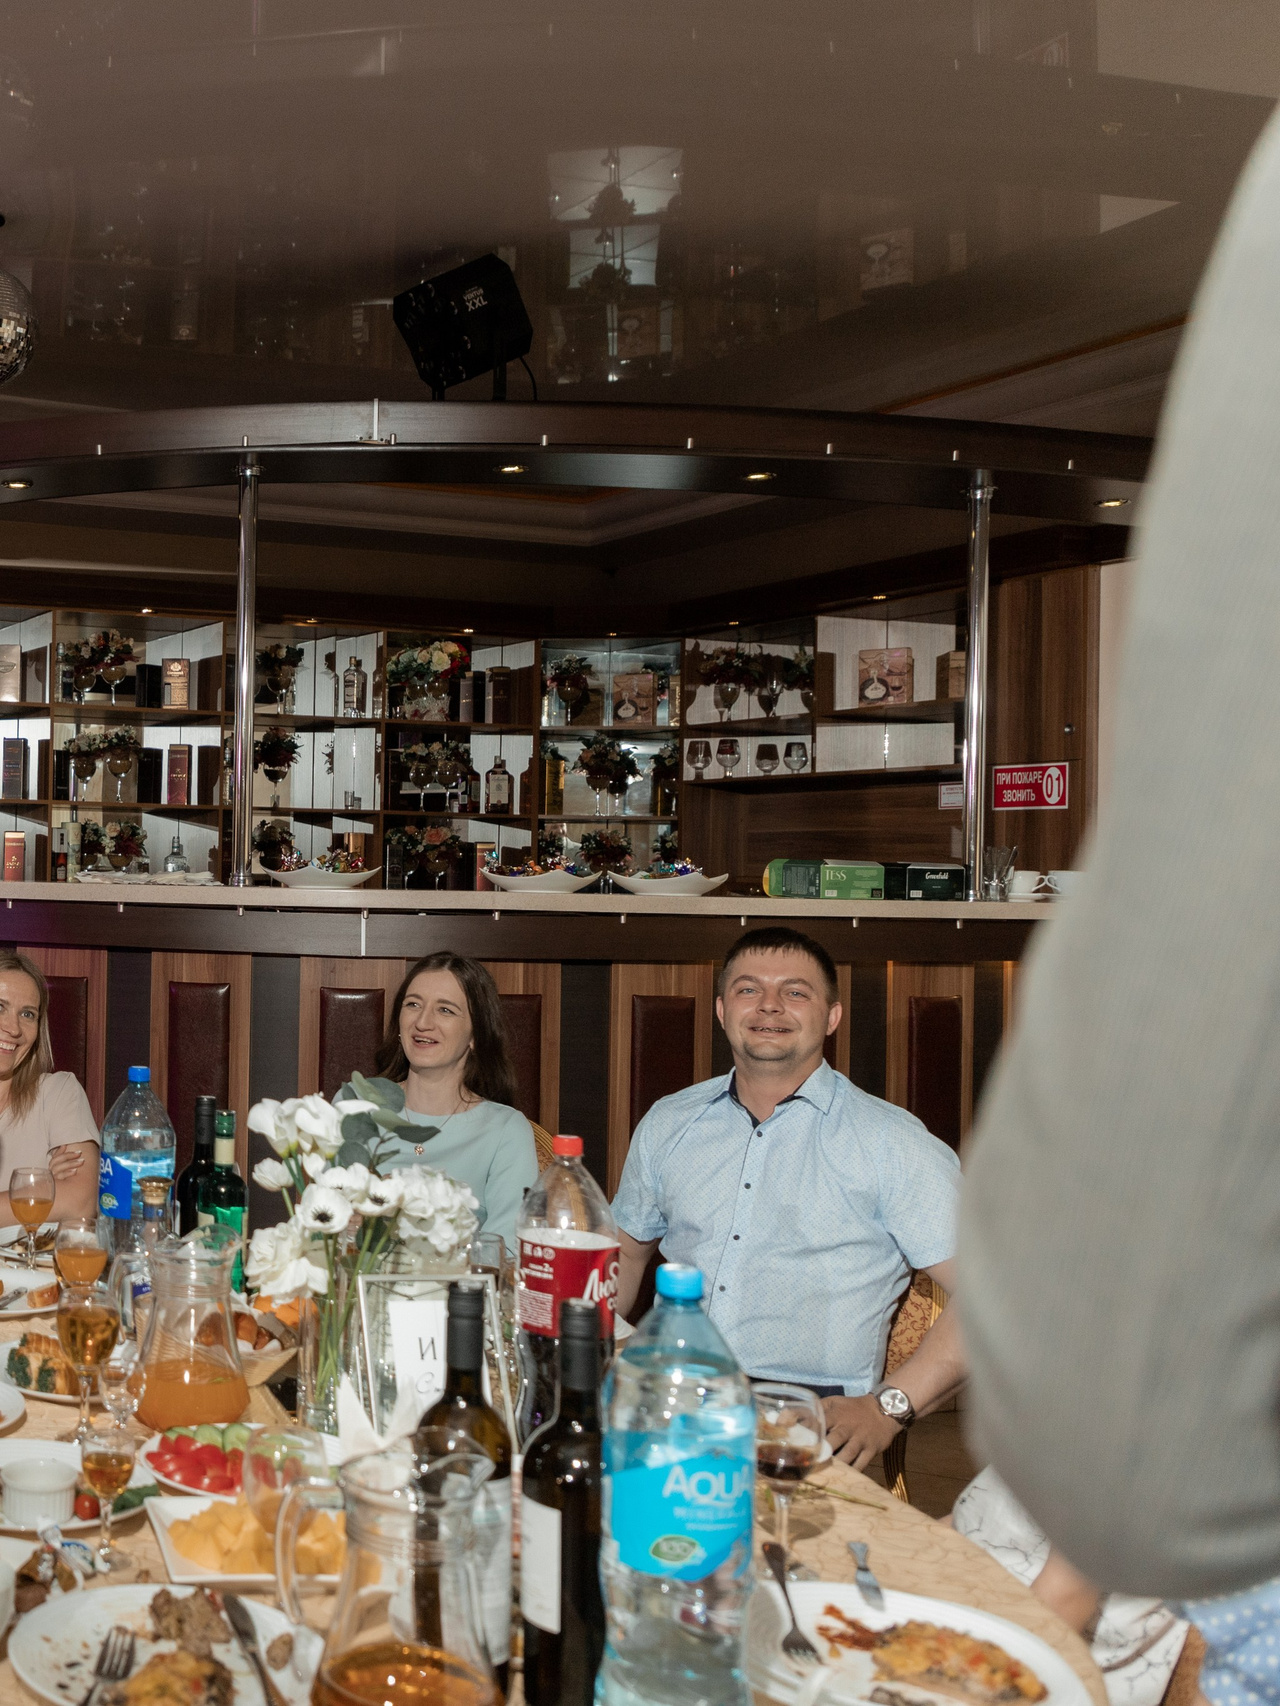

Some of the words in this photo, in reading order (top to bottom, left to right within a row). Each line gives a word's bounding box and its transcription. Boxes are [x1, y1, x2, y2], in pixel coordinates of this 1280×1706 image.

[465, 296, 488, 312] XXL
[996, 772, 1011, 785] ПРИ
[1012, 771, 1043, 784] ПОЖАРЕ
[1045, 773, 1061, 799] 01
[1002, 788, 1036, 802] ЗВОНИТЬ
[824, 869, 847, 881] TESS
